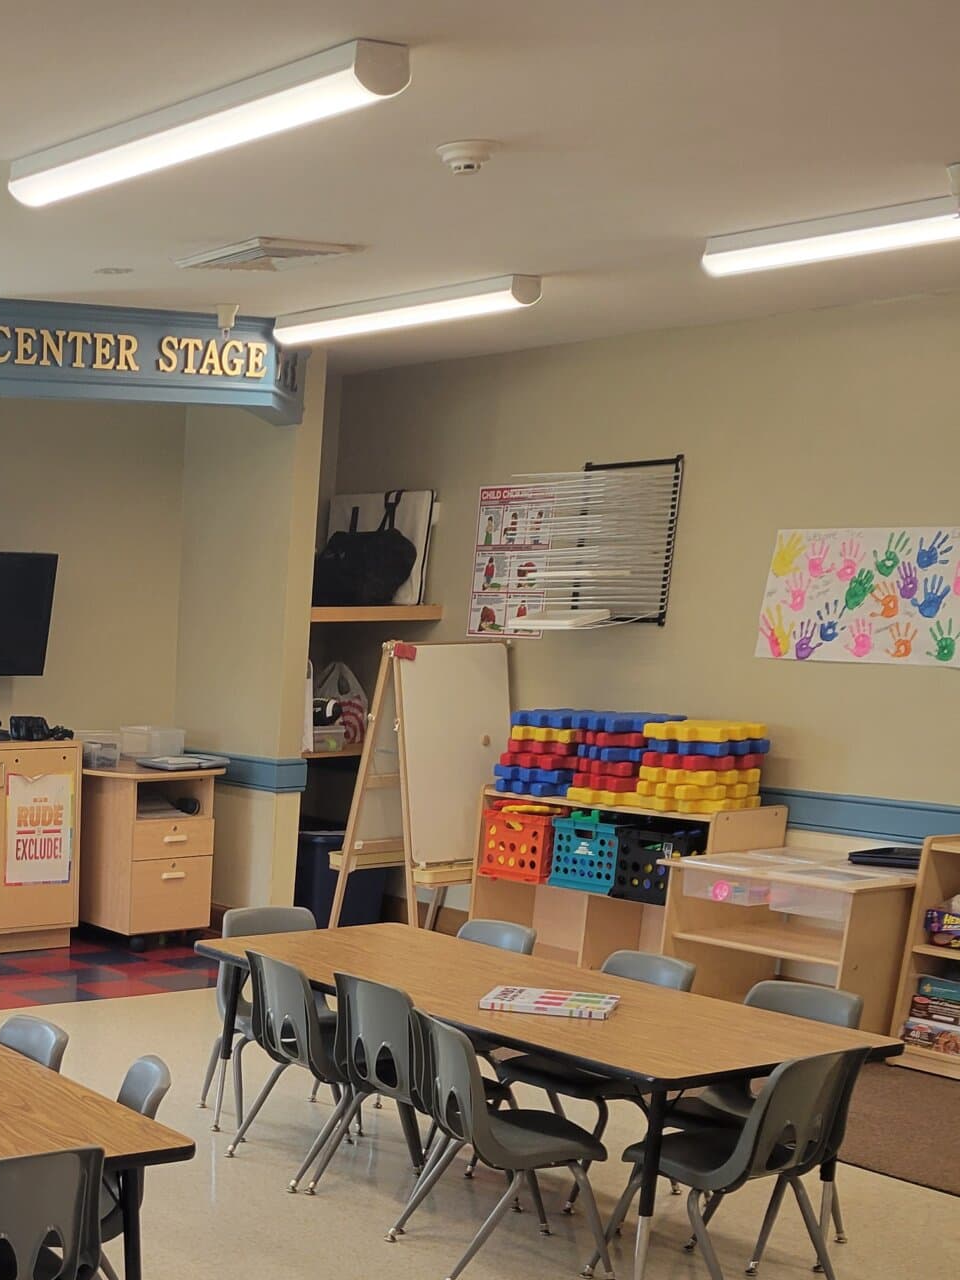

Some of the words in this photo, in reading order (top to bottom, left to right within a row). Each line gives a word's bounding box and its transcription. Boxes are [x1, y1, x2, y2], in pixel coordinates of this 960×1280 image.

[158, 335, 267, 378] STAGE
[482, 490, 501, 500] CHILD
[17, 805, 64, 826] RUDE
[16, 837, 62, 860] EXCLUDE!
